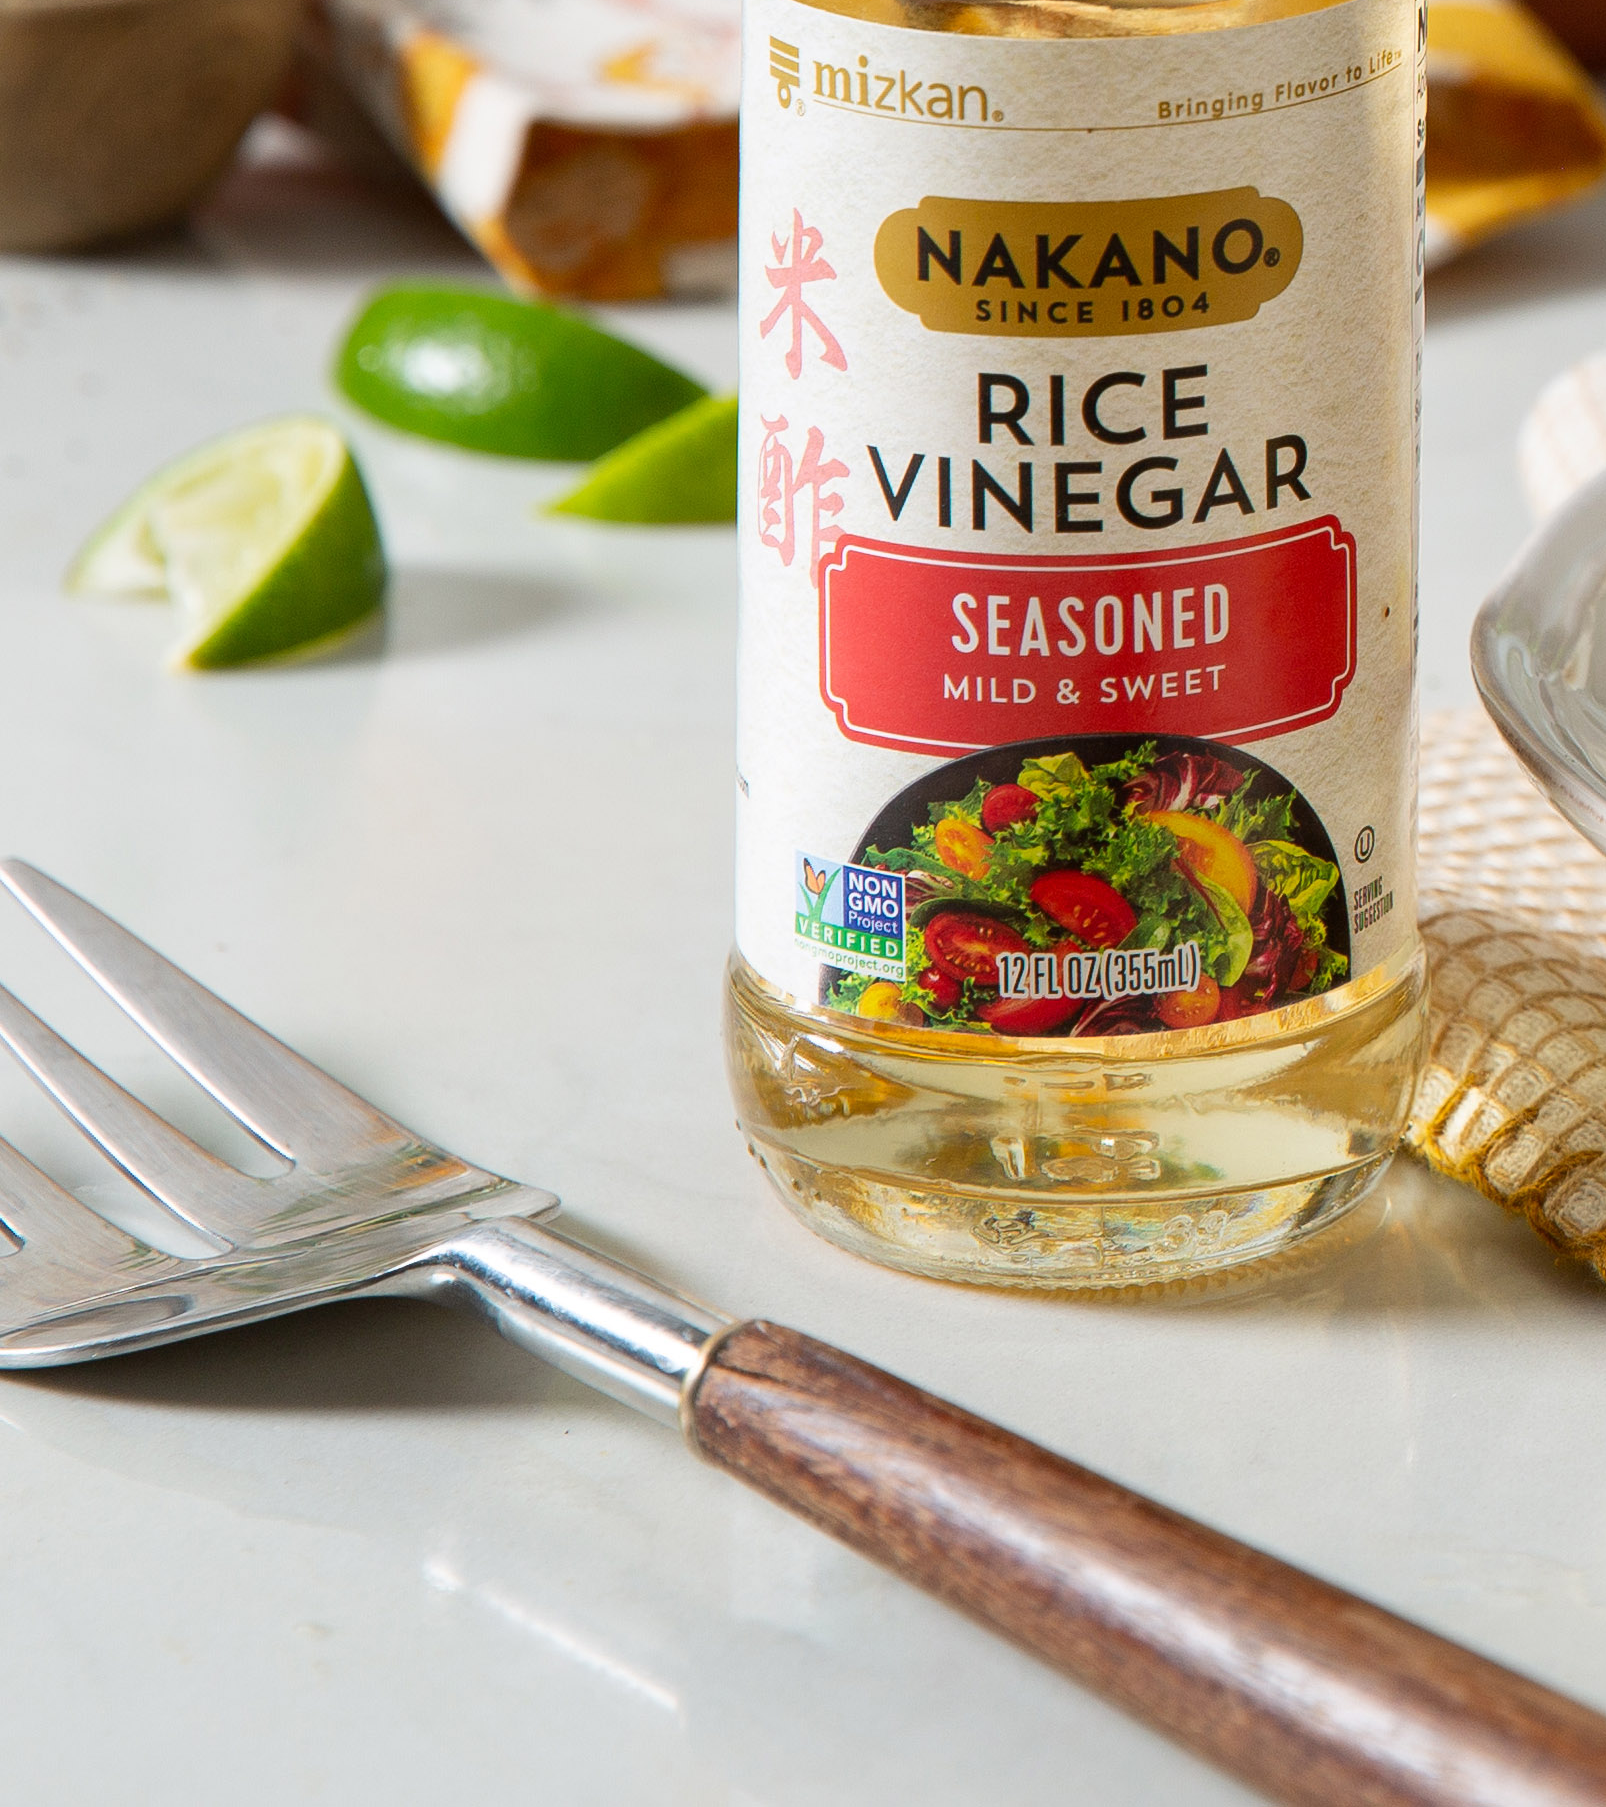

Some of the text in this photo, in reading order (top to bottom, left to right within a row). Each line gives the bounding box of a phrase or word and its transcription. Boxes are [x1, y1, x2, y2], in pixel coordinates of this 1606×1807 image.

[1158, 91, 1264, 119] Bringing
[1275, 73, 1339, 103] Flavor
[1345, 65, 1362, 83] to
[976, 291, 1210, 324] SINCE 1804
[978, 364, 1208, 446] RICE
[867, 433, 1312, 534] VINEGAR
[951, 583, 1230, 657] SEASONED
[943, 664, 1226, 704] MILD & SWEET
[848, 892, 899, 919] GMO
[849, 872, 897, 899] NON
[799, 916, 898, 958] VERIFIED
[849, 910, 898, 935] Project
[794, 938, 904, 979] nongmoproject.org
[1000, 944, 1197, 996] 12 FL OZ (355mL)
